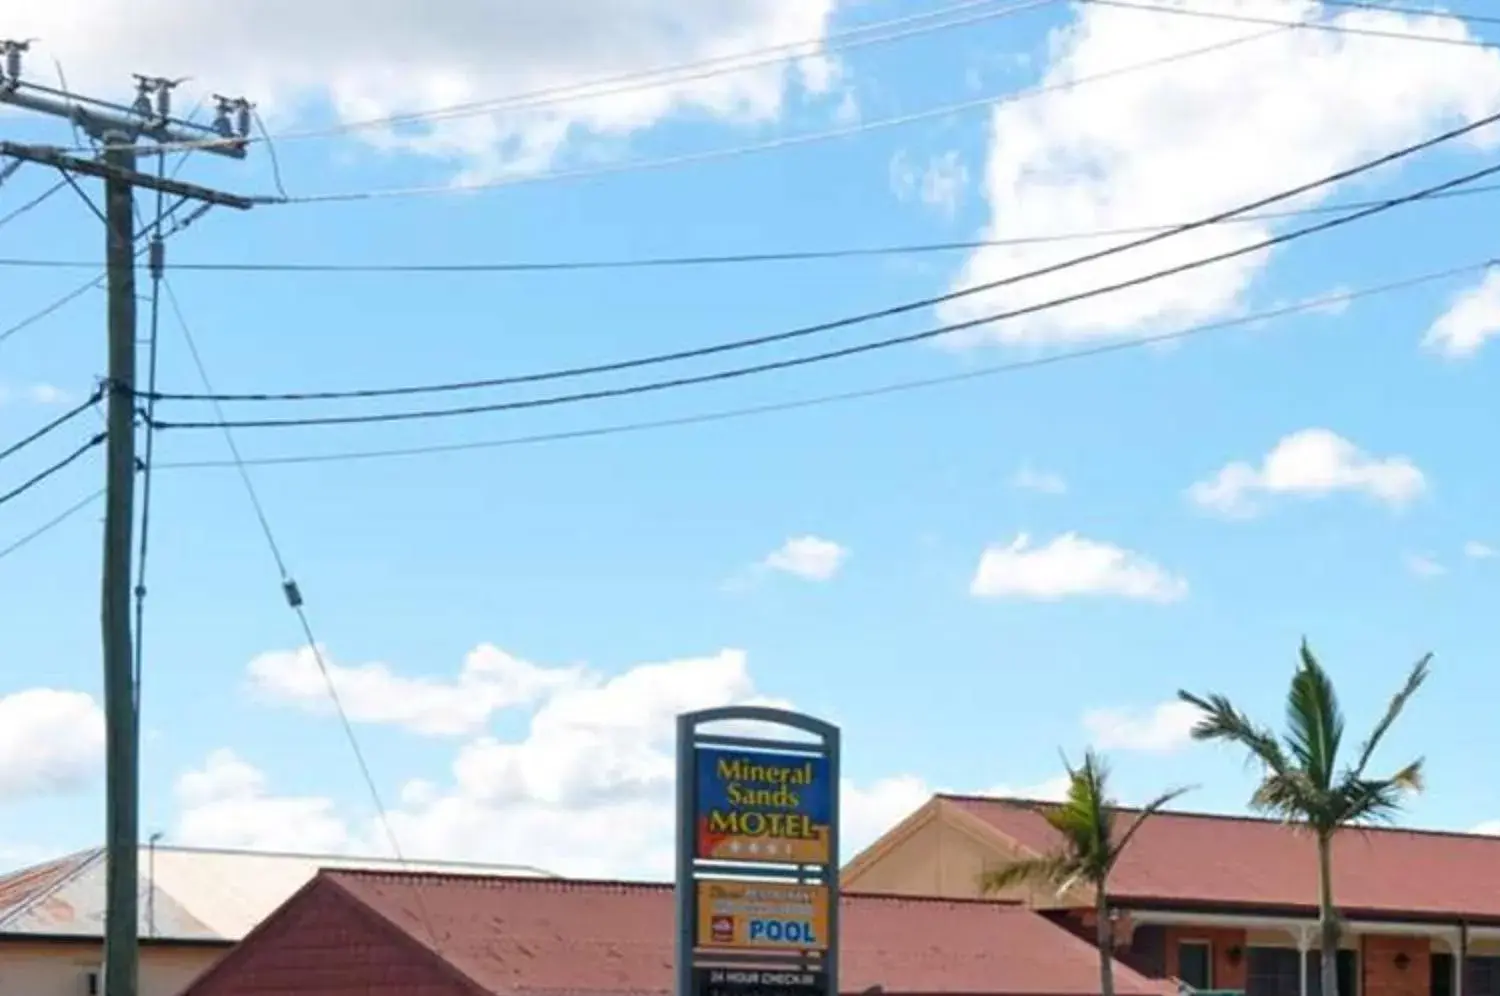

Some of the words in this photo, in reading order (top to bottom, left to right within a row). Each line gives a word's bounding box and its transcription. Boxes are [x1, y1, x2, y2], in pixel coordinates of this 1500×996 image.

[717, 757, 812, 785] Mineral
[727, 782, 799, 807] Sands
[709, 809, 815, 838] MOTEL
[750, 919, 816, 943] POOL
